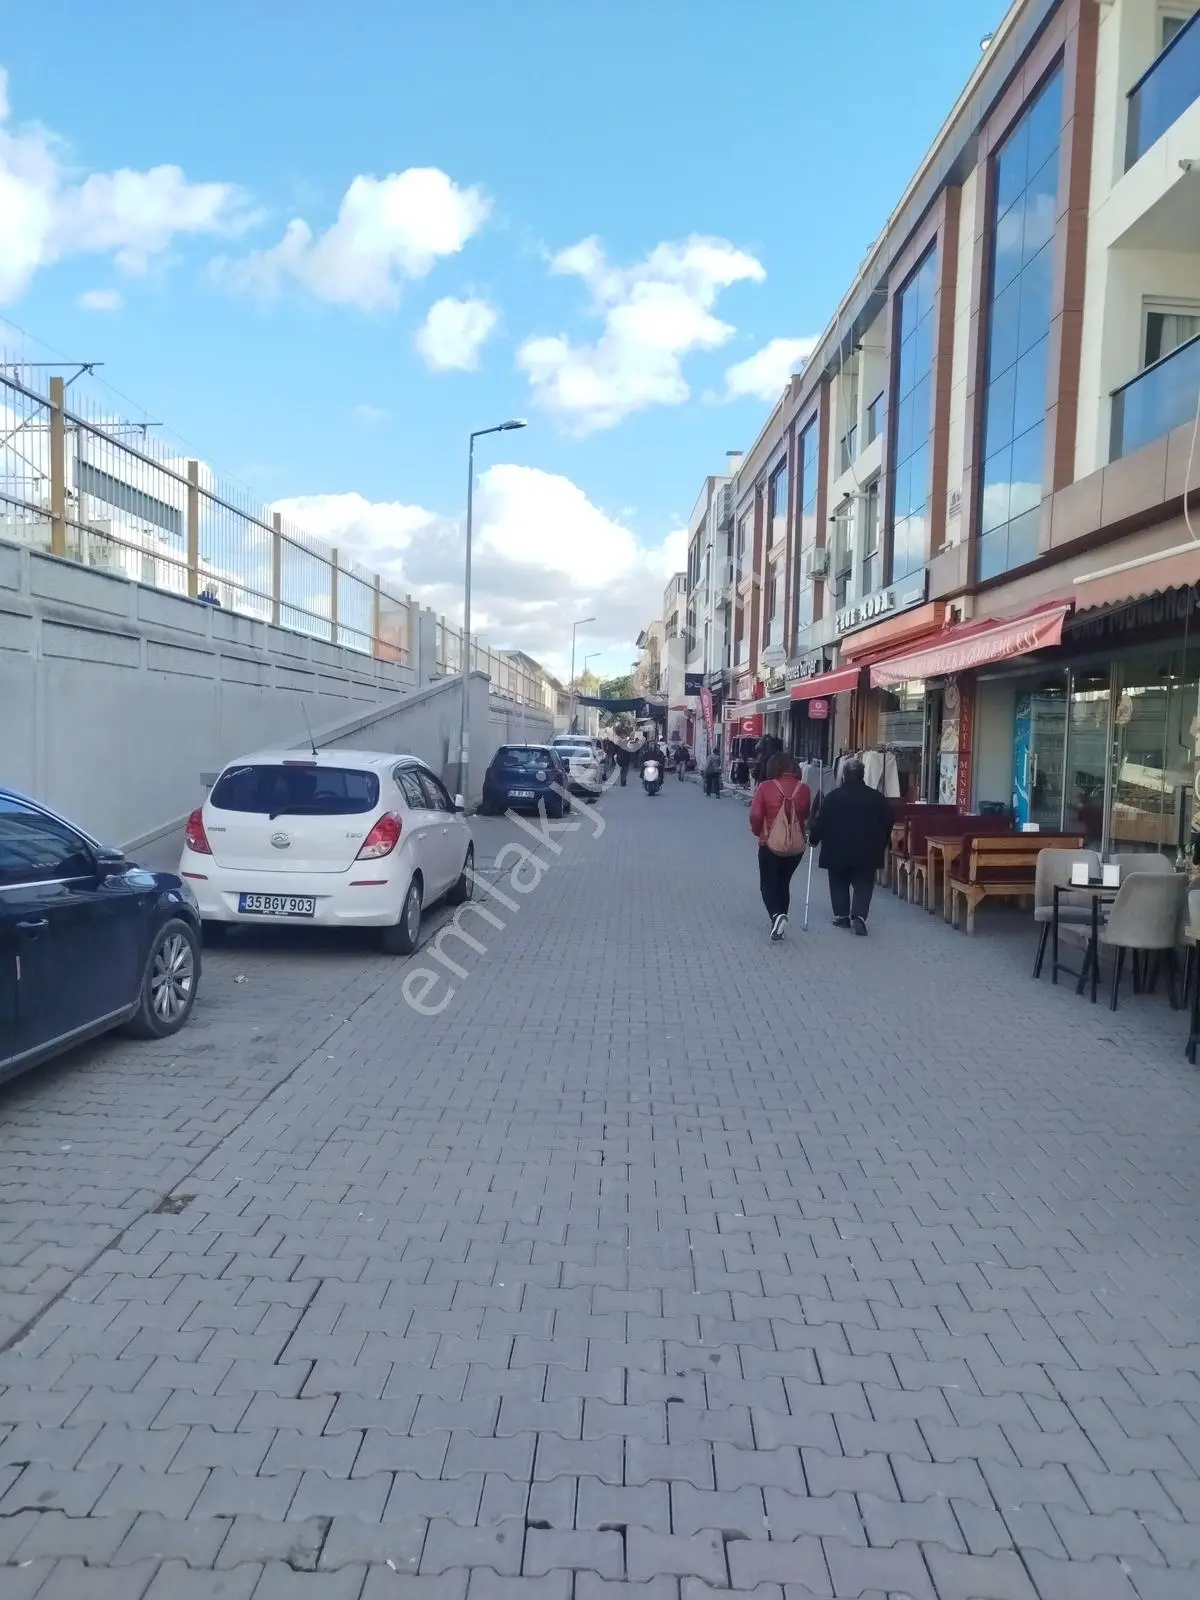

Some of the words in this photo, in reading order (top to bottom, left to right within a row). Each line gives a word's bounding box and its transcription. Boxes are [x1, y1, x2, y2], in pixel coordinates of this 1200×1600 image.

[247, 895, 262, 909] 35
[264, 897, 287, 910] BGV
[289, 898, 312, 912] 903
